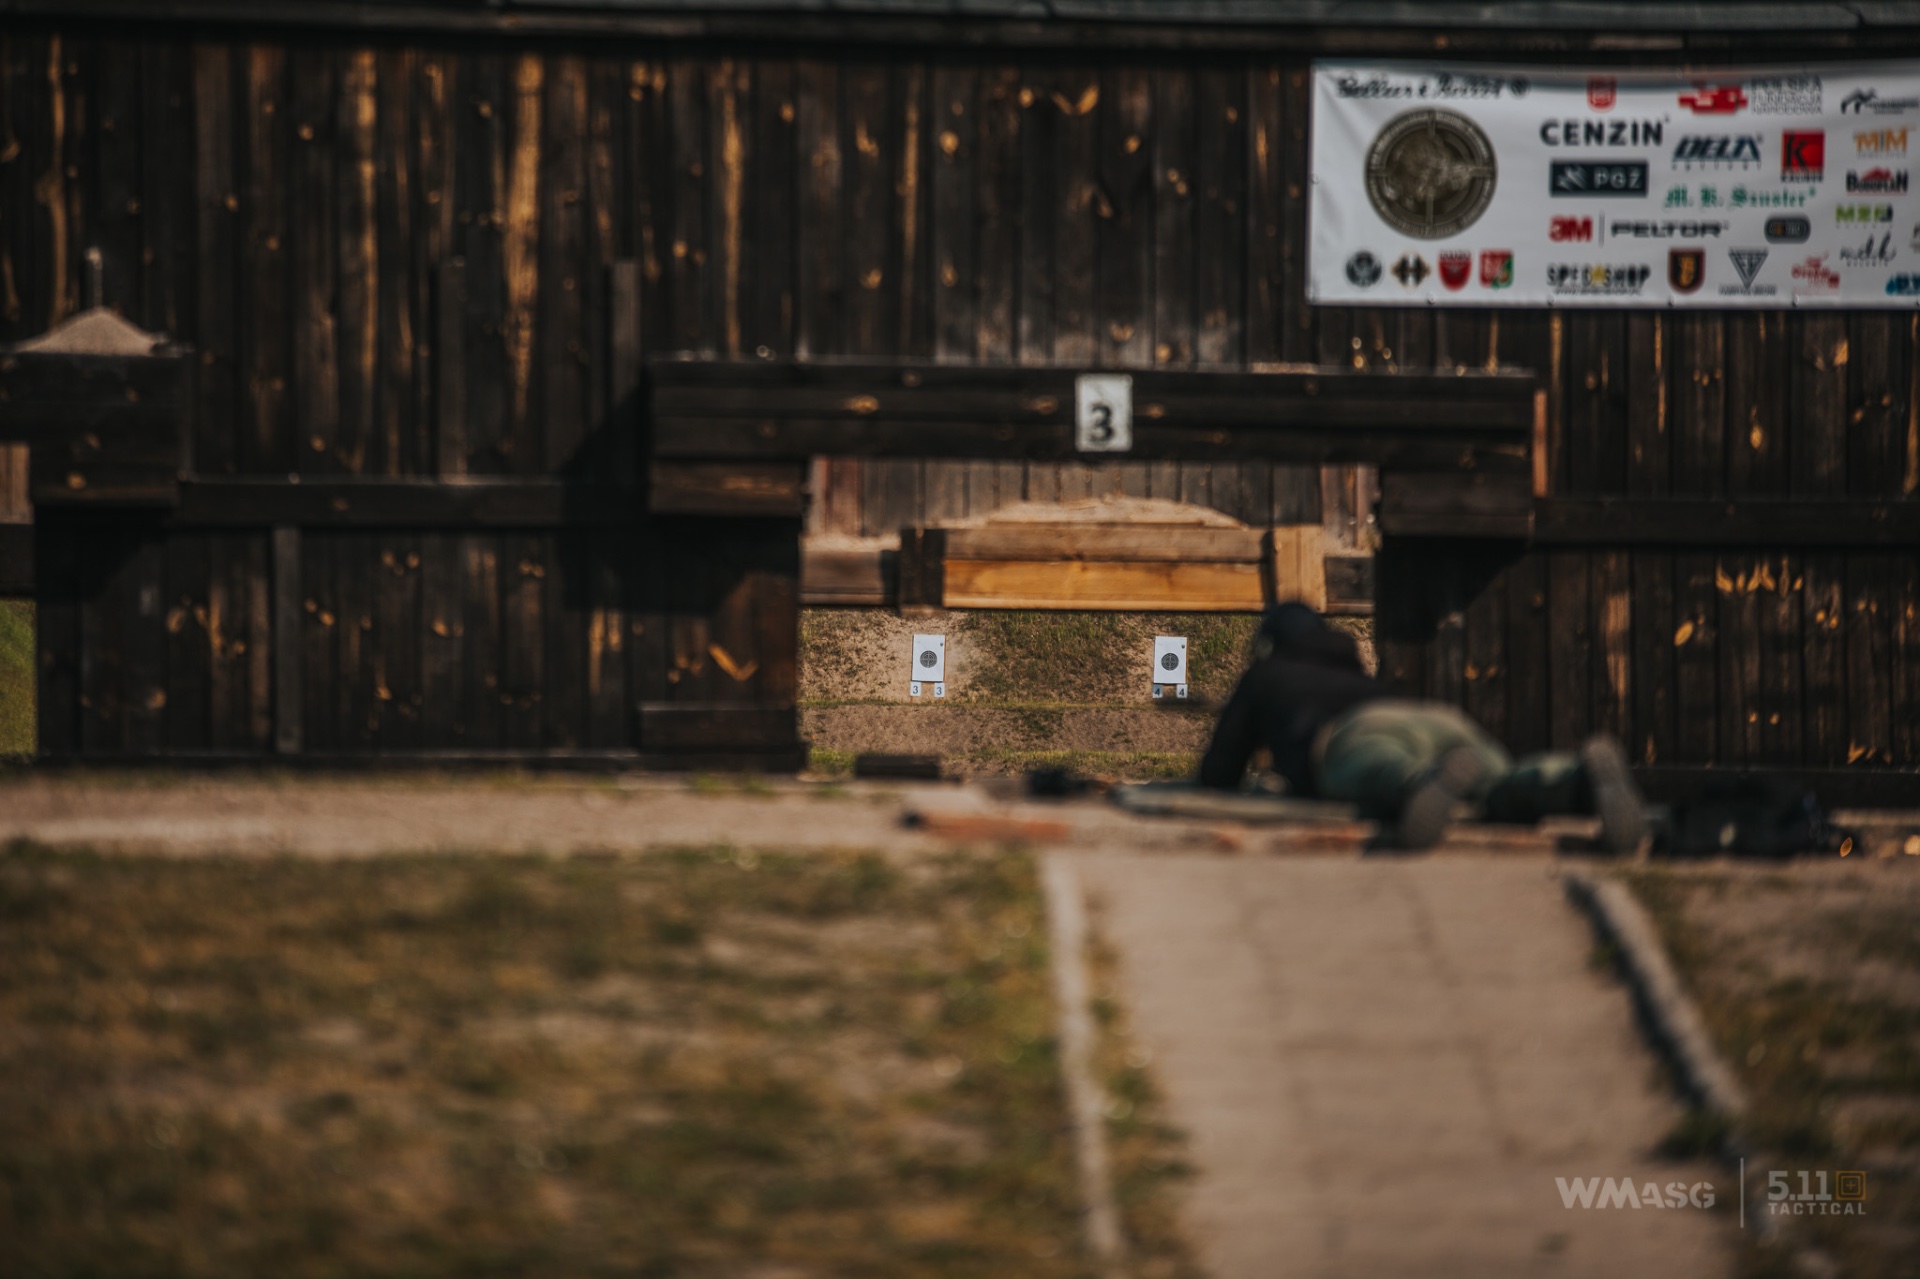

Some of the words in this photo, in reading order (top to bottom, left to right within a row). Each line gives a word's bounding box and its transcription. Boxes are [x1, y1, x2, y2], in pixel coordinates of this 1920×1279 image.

[1540, 118, 1663, 146] CENZIN
[1594, 167, 1641, 189] PGZ
[1549, 216, 1593, 243] 3M
[1611, 219, 1721, 238] PELTOR
[1090, 402, 1115, 444] 3
[912, 685, 919, 695] 3
[936, 686, 942, 696] 3
[1154, 688, 1161, 696] 4
[1178, 688, 1185, 697] 4
